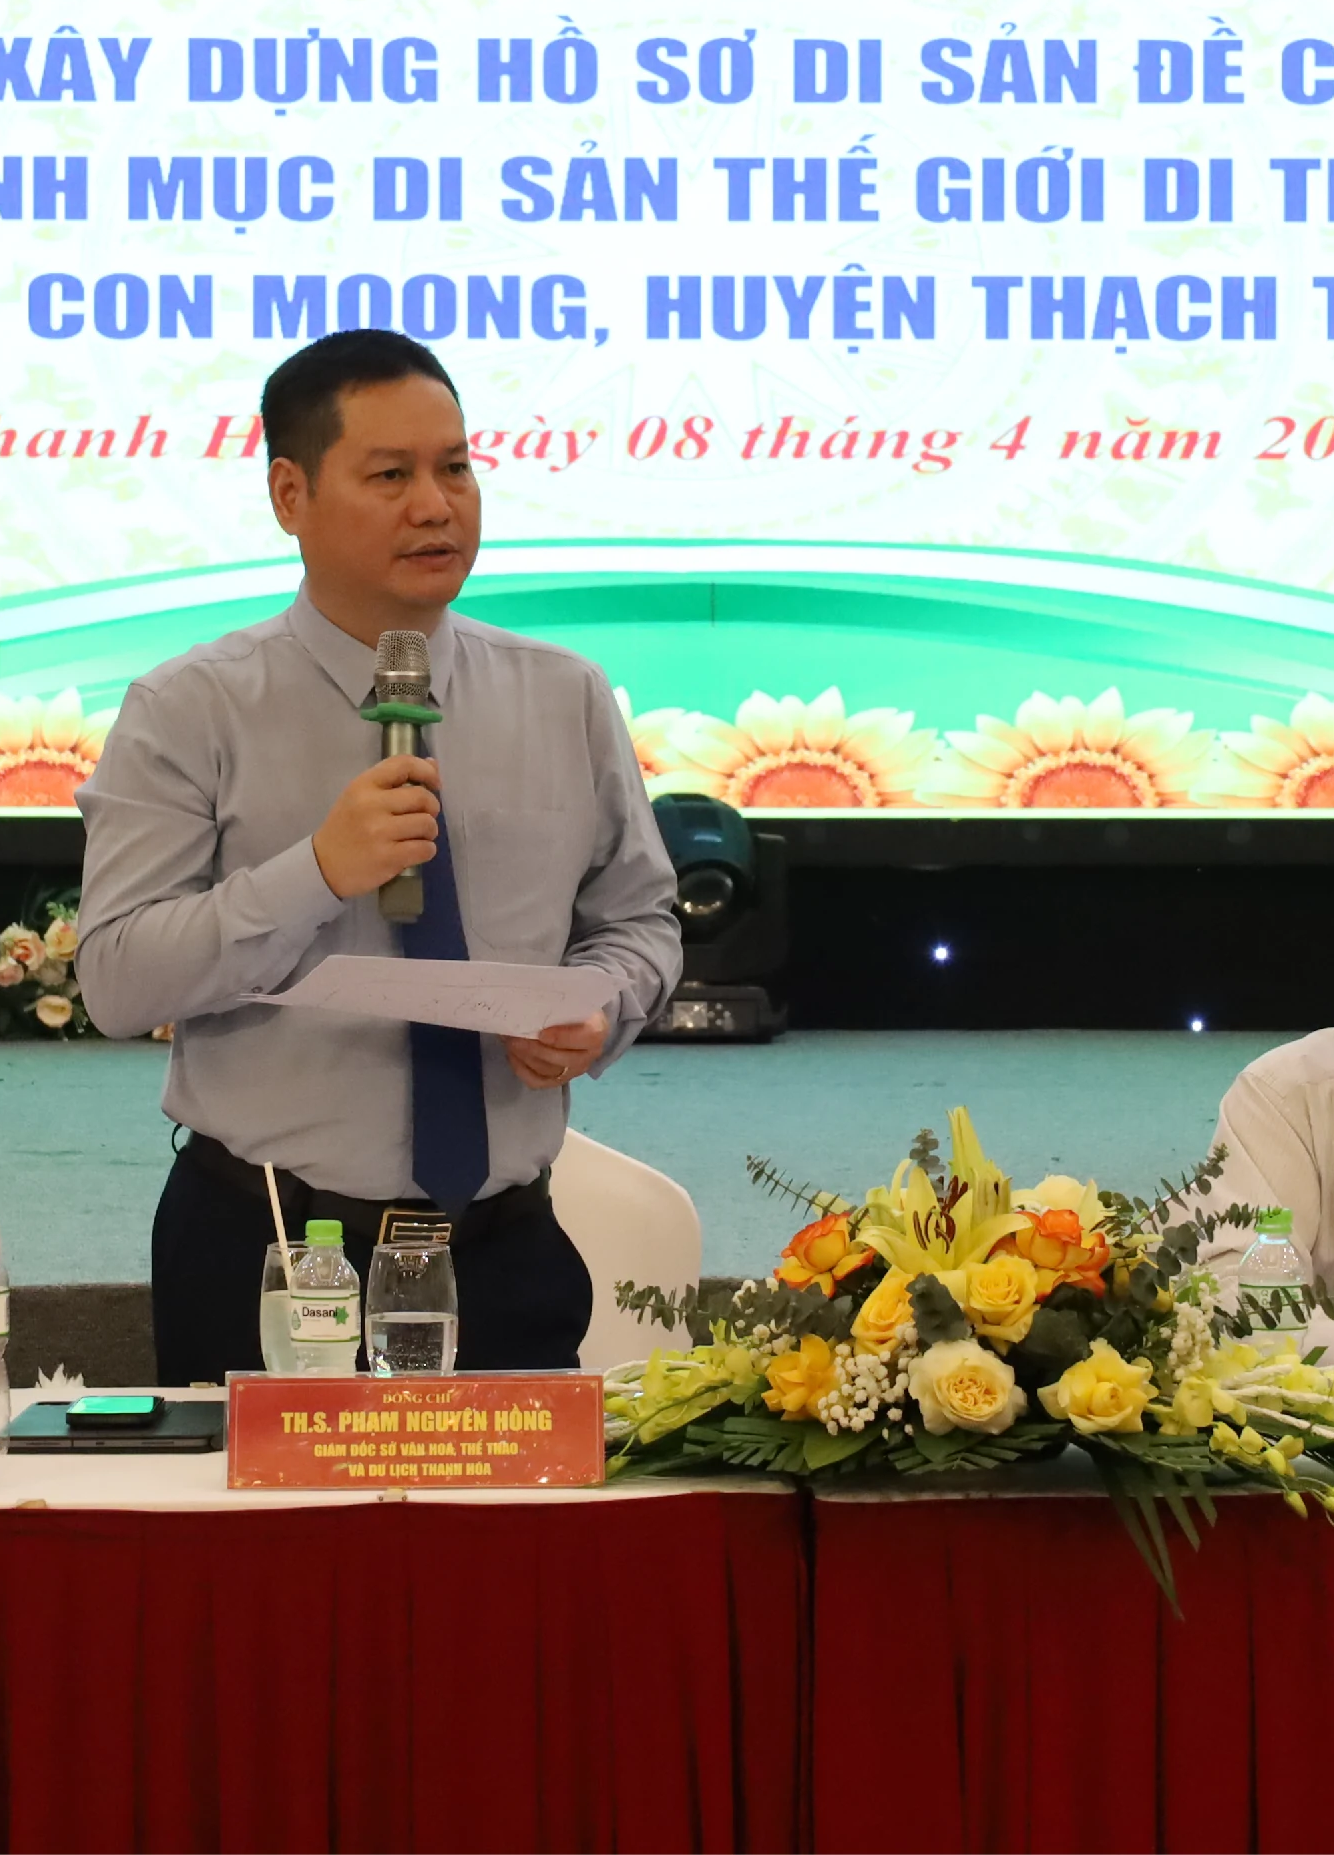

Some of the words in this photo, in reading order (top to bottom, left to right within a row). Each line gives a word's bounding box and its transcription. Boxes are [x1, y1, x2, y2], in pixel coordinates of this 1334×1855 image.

[188, 27, 438, 116] DỰNG
[477, 15, 598, 104] HỒ
[636, 28, 757, 105] SƠ
[793, 39, 882, 103] DI
[920, 22, 1097, 105] SẢN
[1133, 16, 1245, 105] ĐỀ
[127, 155, 334, 234] MỤC
[373, 156, 463, 221] DI
[501, 140, 678, 222] SẢN
[713, 134, 879, 222] THẾ
[915, 145, 1104, 223] GIỚI
[1144, 158, 1233, 222] DI
[27, 272, 213, 340] CON
[252, 273, 609, 347] MOONG,
[646, 263, 935, 354] HUYỆN
[971, 274, 1277, 354] THẠCH
[469, 414, 598, 472] gày
[627, 415, 714, 460] 08
[740, 414, 962, 473] tháng
[989, 415, 1033, 461] 4
[1060, 417, 1222, 461] năm
[281, 1411, 332, 1434] TH.S.
